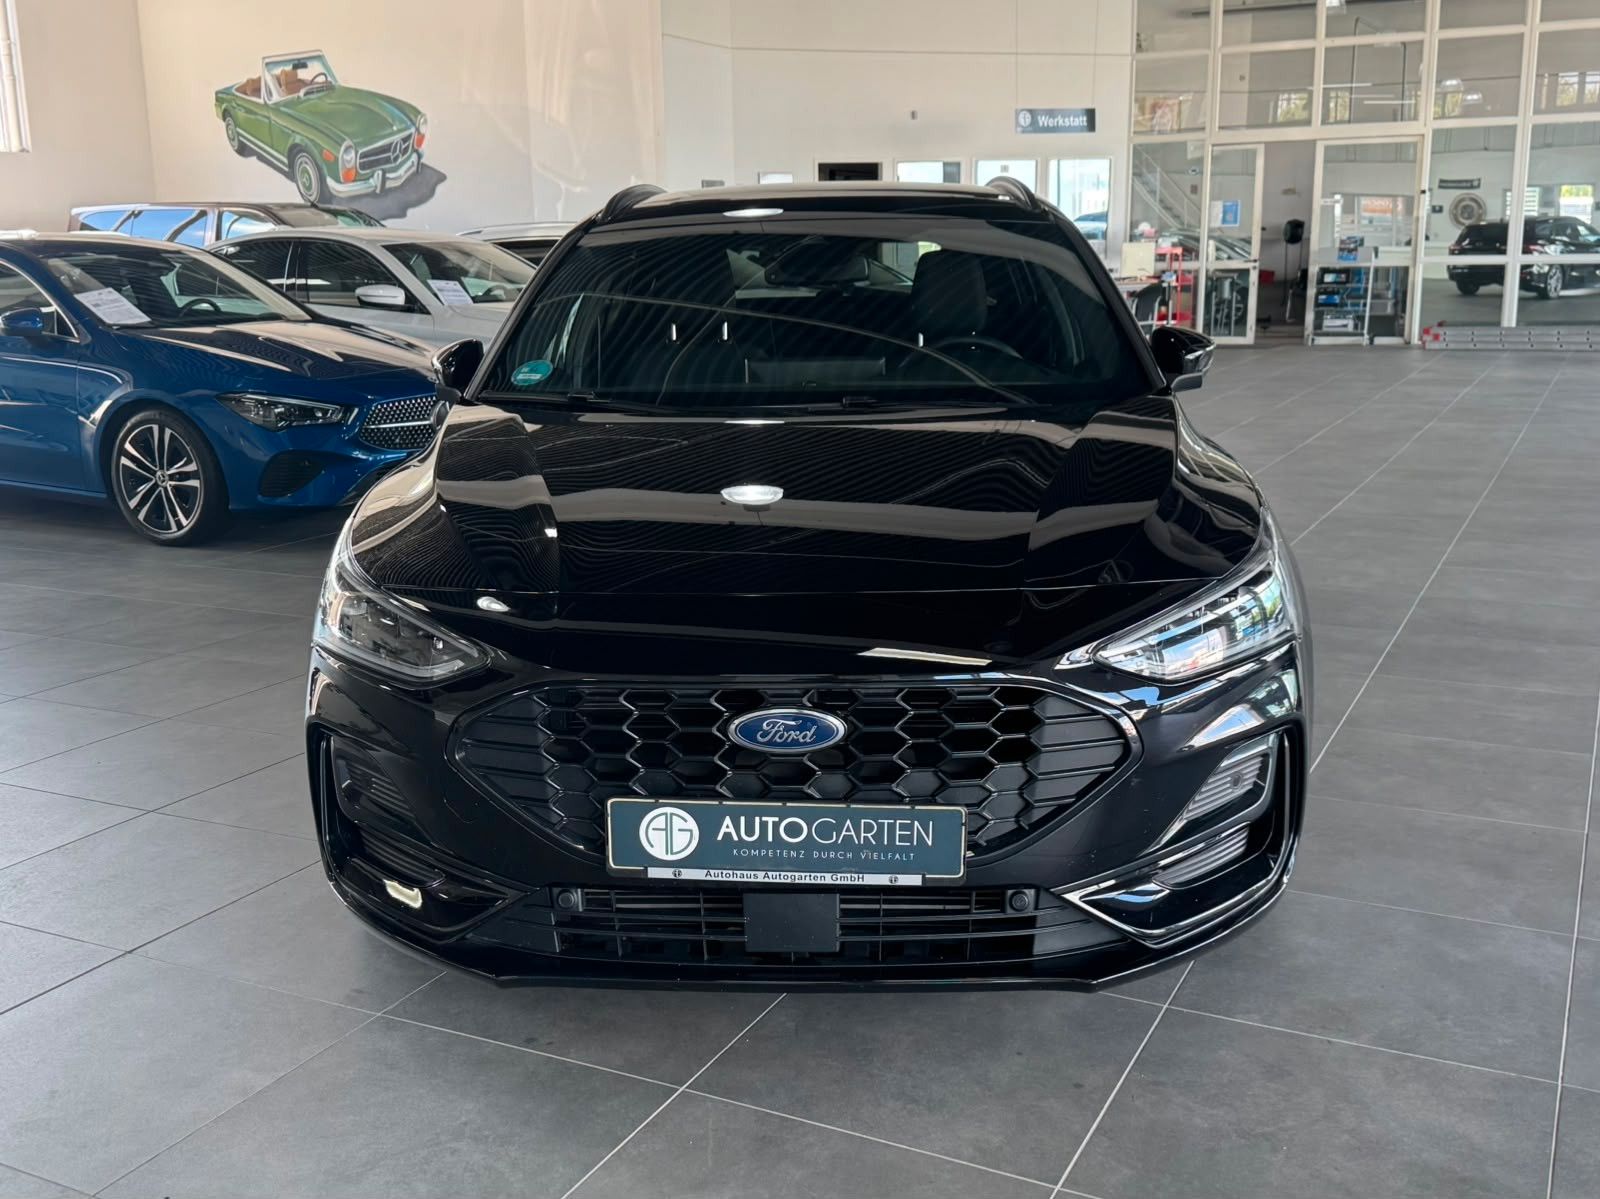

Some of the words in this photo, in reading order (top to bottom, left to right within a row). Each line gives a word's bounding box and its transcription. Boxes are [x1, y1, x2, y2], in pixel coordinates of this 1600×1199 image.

[1037, 114, 1087, 127] Werkstatt
[756, 718, 818, 743] Ford
[716, 815, 933, 847] AUTOGARTEN
[733, 848, 806, 859] KOMPETENZ
[813, 850, 853, 860] DURCH
[860, 851, 916, 861] VIELFALT
[704, 869, 759, 880] Autohaus
[762, 871, 826, 883] Autogarten
[830, 873, 865, 883] GmbH
